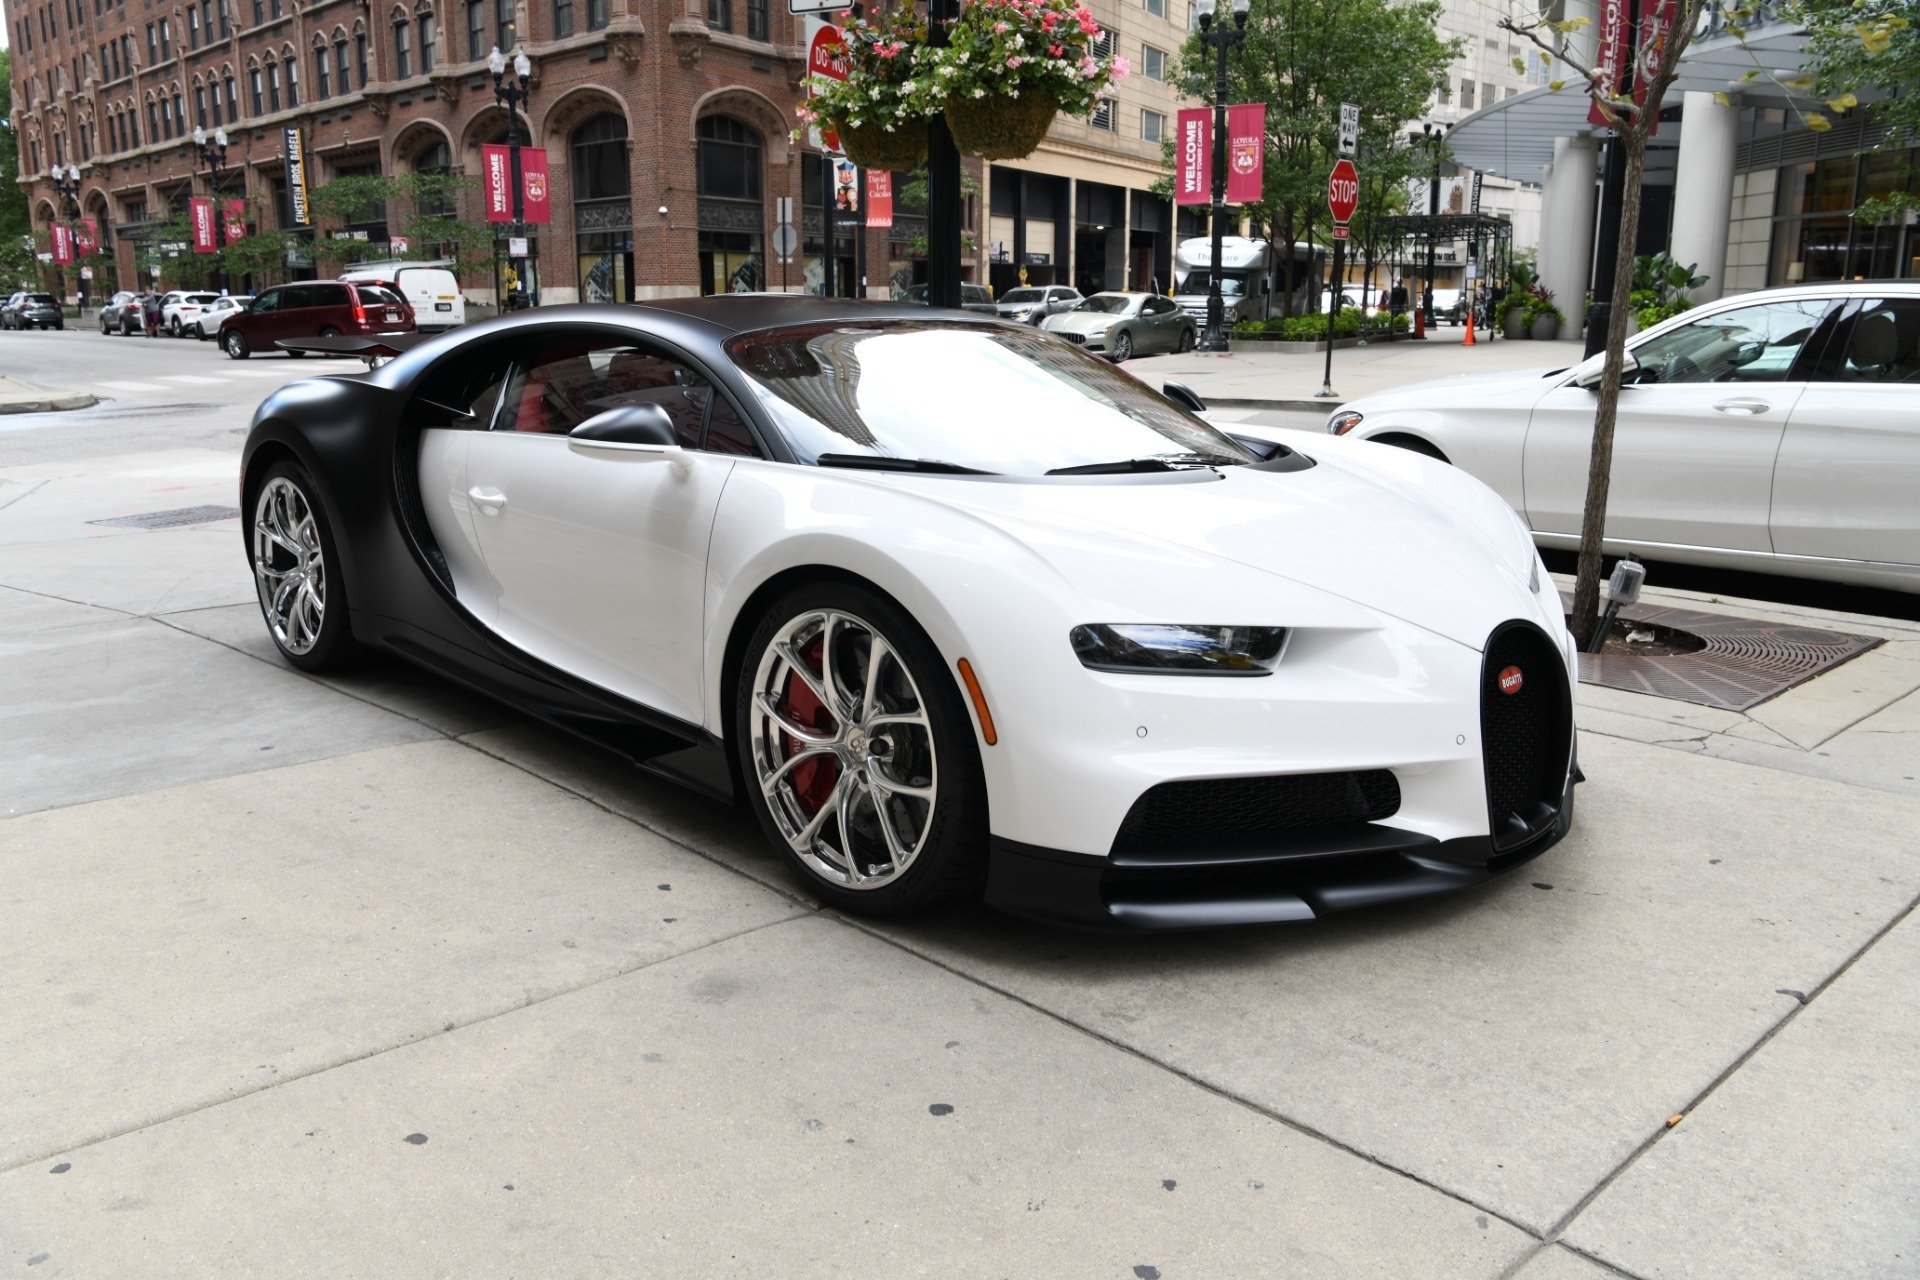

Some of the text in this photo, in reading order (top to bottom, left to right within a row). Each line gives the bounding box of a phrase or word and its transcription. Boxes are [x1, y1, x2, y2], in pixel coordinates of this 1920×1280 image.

[1601, 0, 1618, 99] WELCO
[1342, 107, 1357, 121] ONE
[1342, 125, 1355, 136] WAY
[287, 129, 300, 161] BAGELS
[1185, 120, 1197, 193] WELCOME
[1233, 136, 1259, 144] LOYOLA
[490, 153, 502, 212] WELCOME
[1330, 179, 1357, 204] STOP
[1471, 174, 1481, 215] NORDSTRO
[293, 186, 305, 223] EINSTEIN
[196, 205, 206, 247] WELCOME
